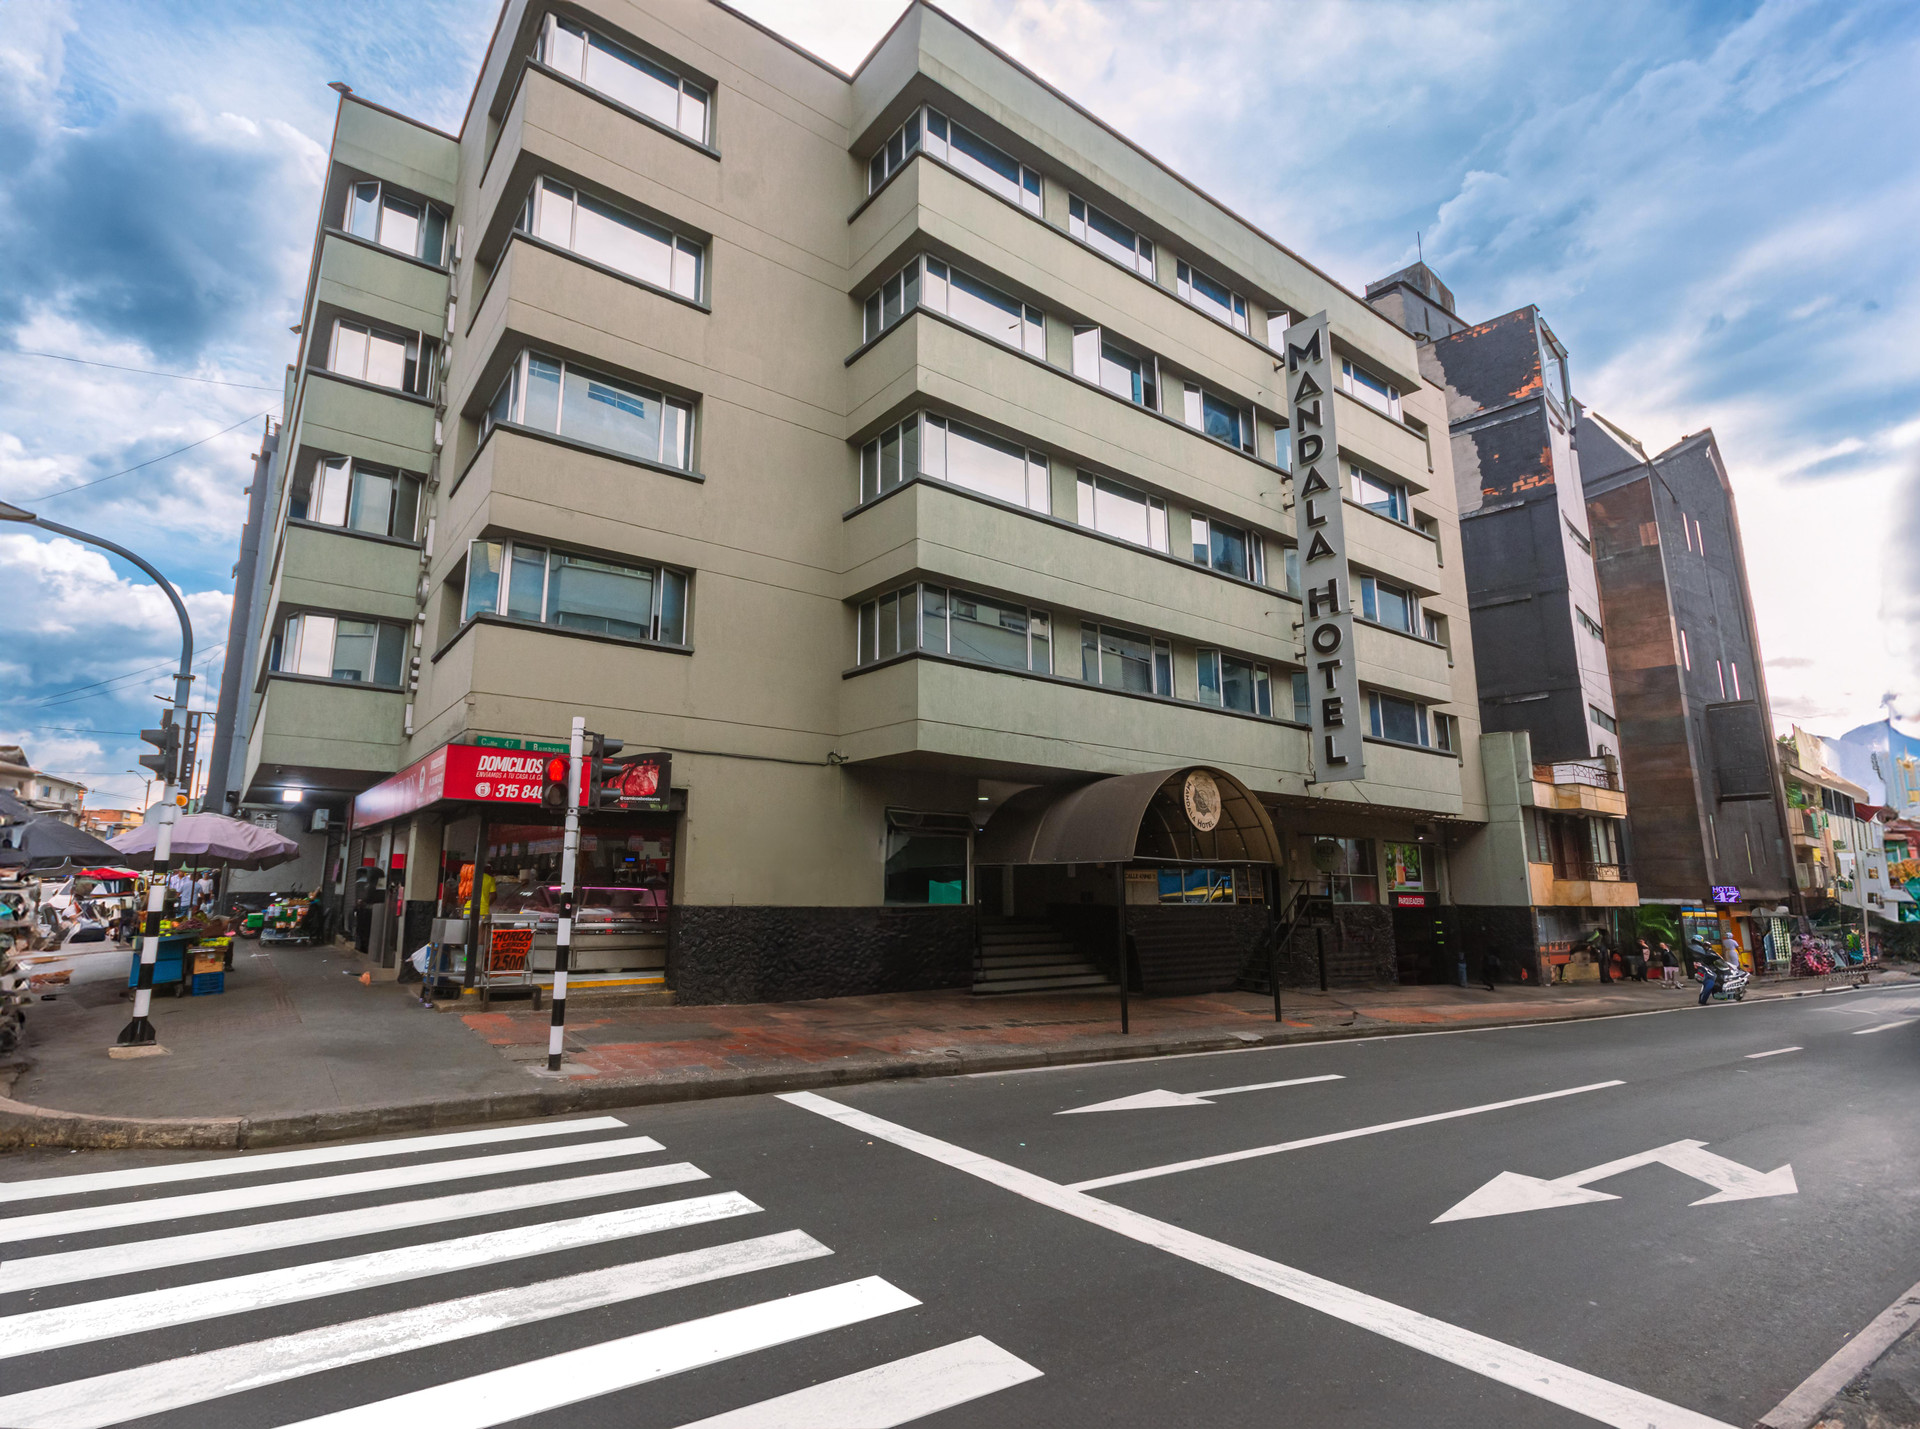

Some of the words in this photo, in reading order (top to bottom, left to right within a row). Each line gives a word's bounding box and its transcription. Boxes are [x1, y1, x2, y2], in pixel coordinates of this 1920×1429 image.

[1288, 328, 1336, 564] MANDALA
[1308, 578, 1349, 765] HOTEL
[504, 740, 514, 748] 47
[478, 755, 543, 774] DOMICILIOS
[475, 771, 502, 779] ENVIAMOS
[495, 783, 520, 798] 315
[1197, 819, 1215, 829] HOTEL
[1398, 896, 1425, 905] PARQUEADERO
[1714, 892, 1740, 903] 47
